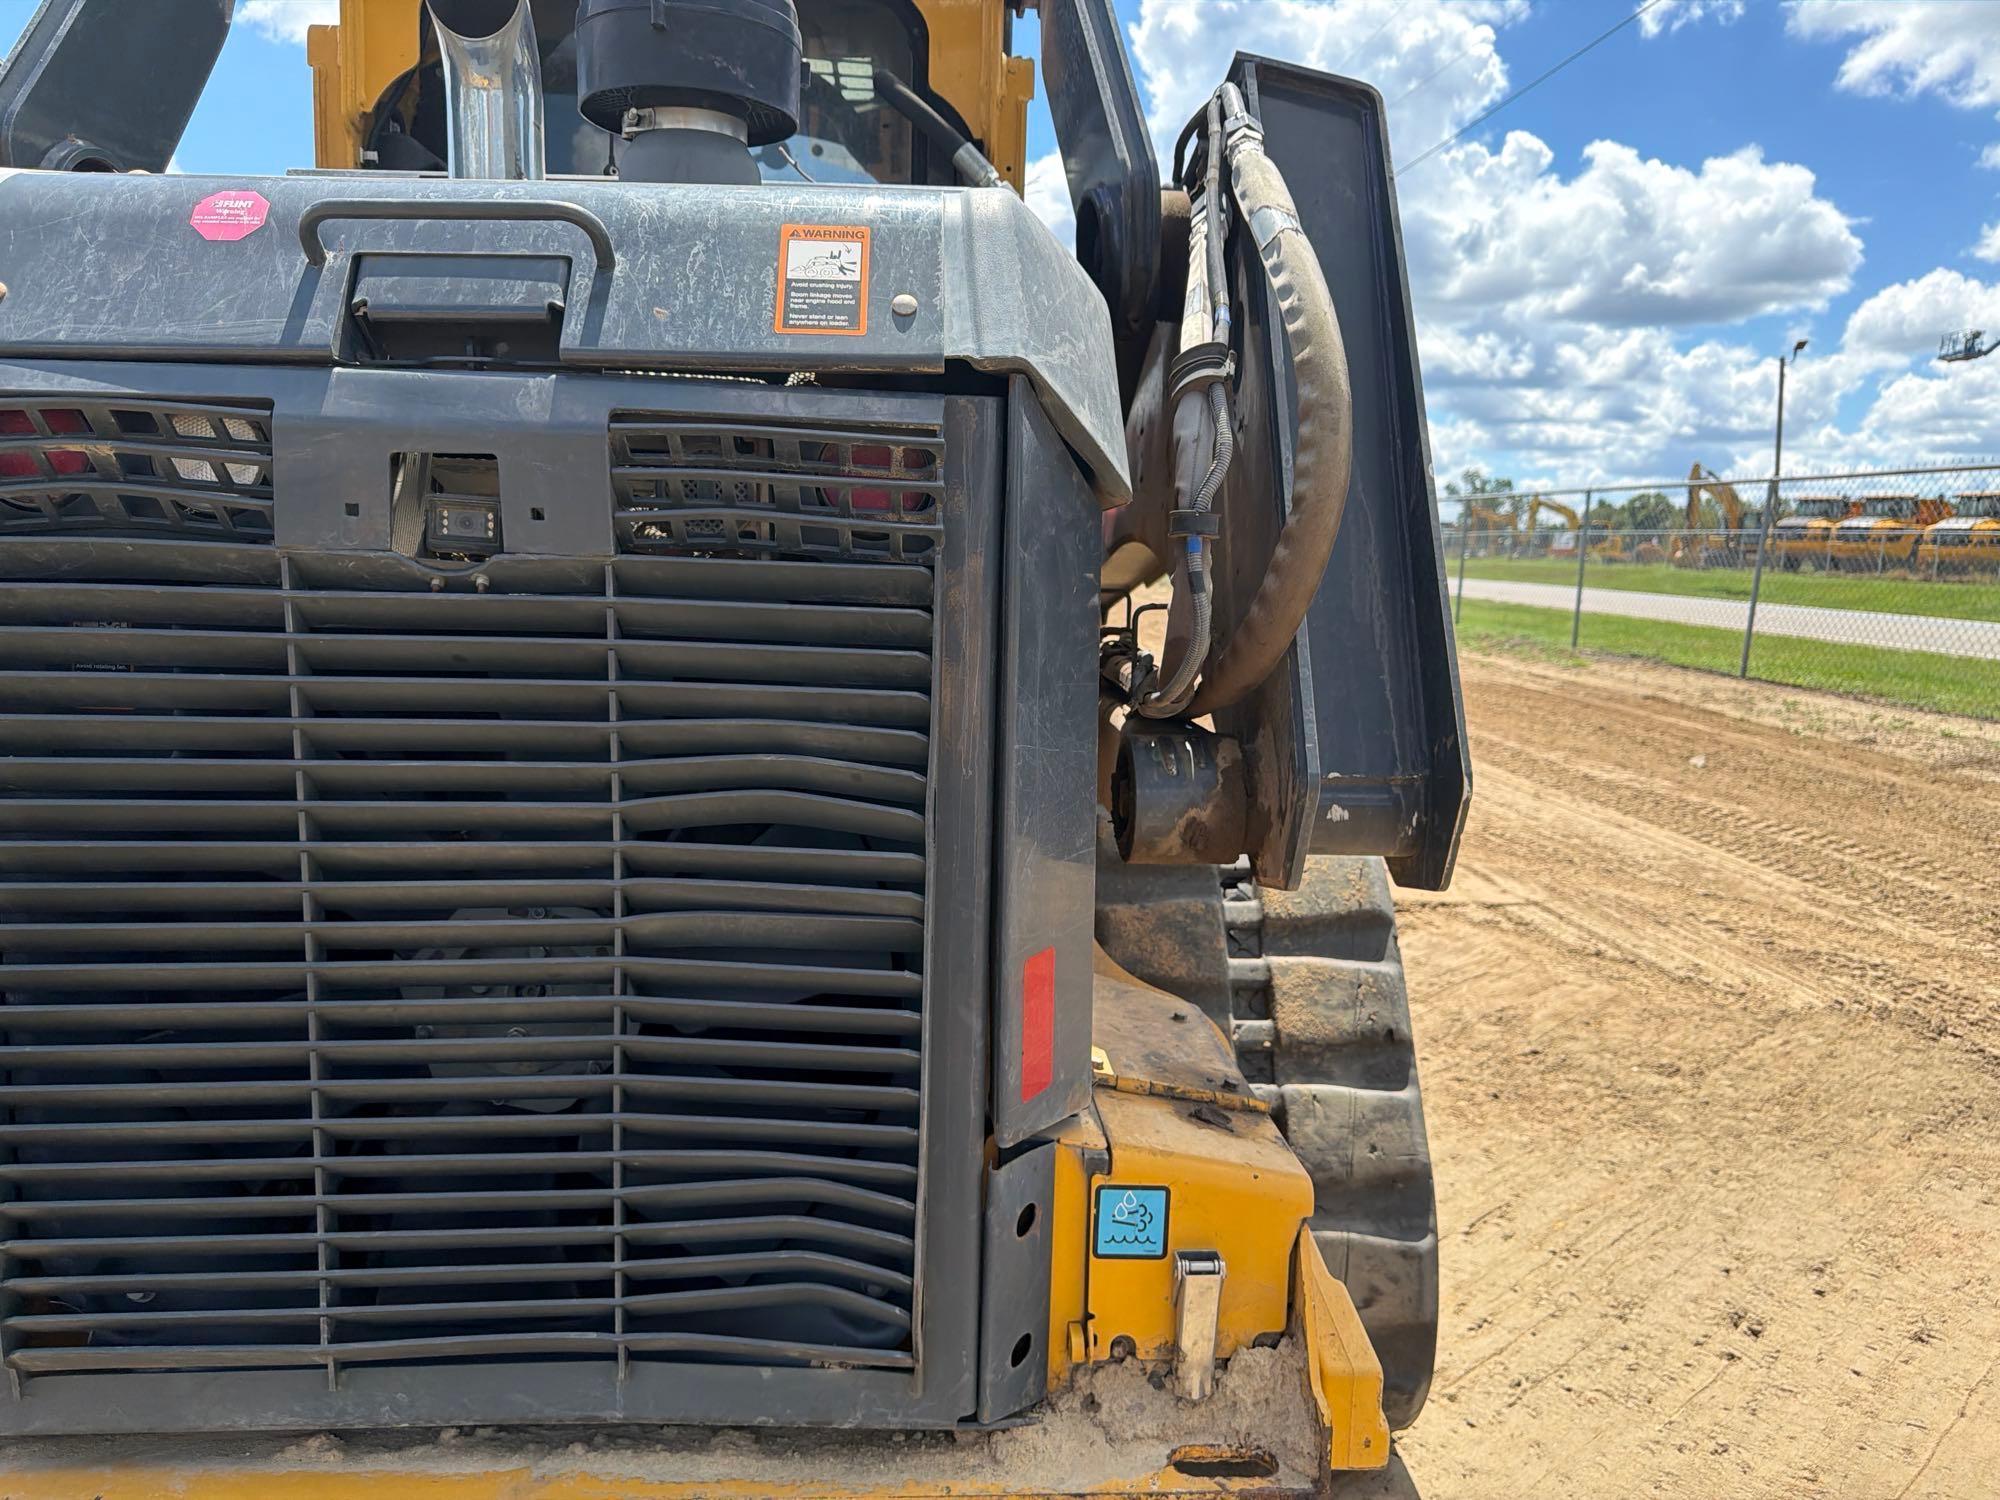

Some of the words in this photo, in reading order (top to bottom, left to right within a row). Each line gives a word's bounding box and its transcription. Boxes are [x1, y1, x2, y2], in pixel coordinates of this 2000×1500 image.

[222, 200, 254, 208] FLINT
[802, 229, 865, 239] WARNING
[809, 282, 835, 290] crushing
[836, 282, 853, 290] injury.
